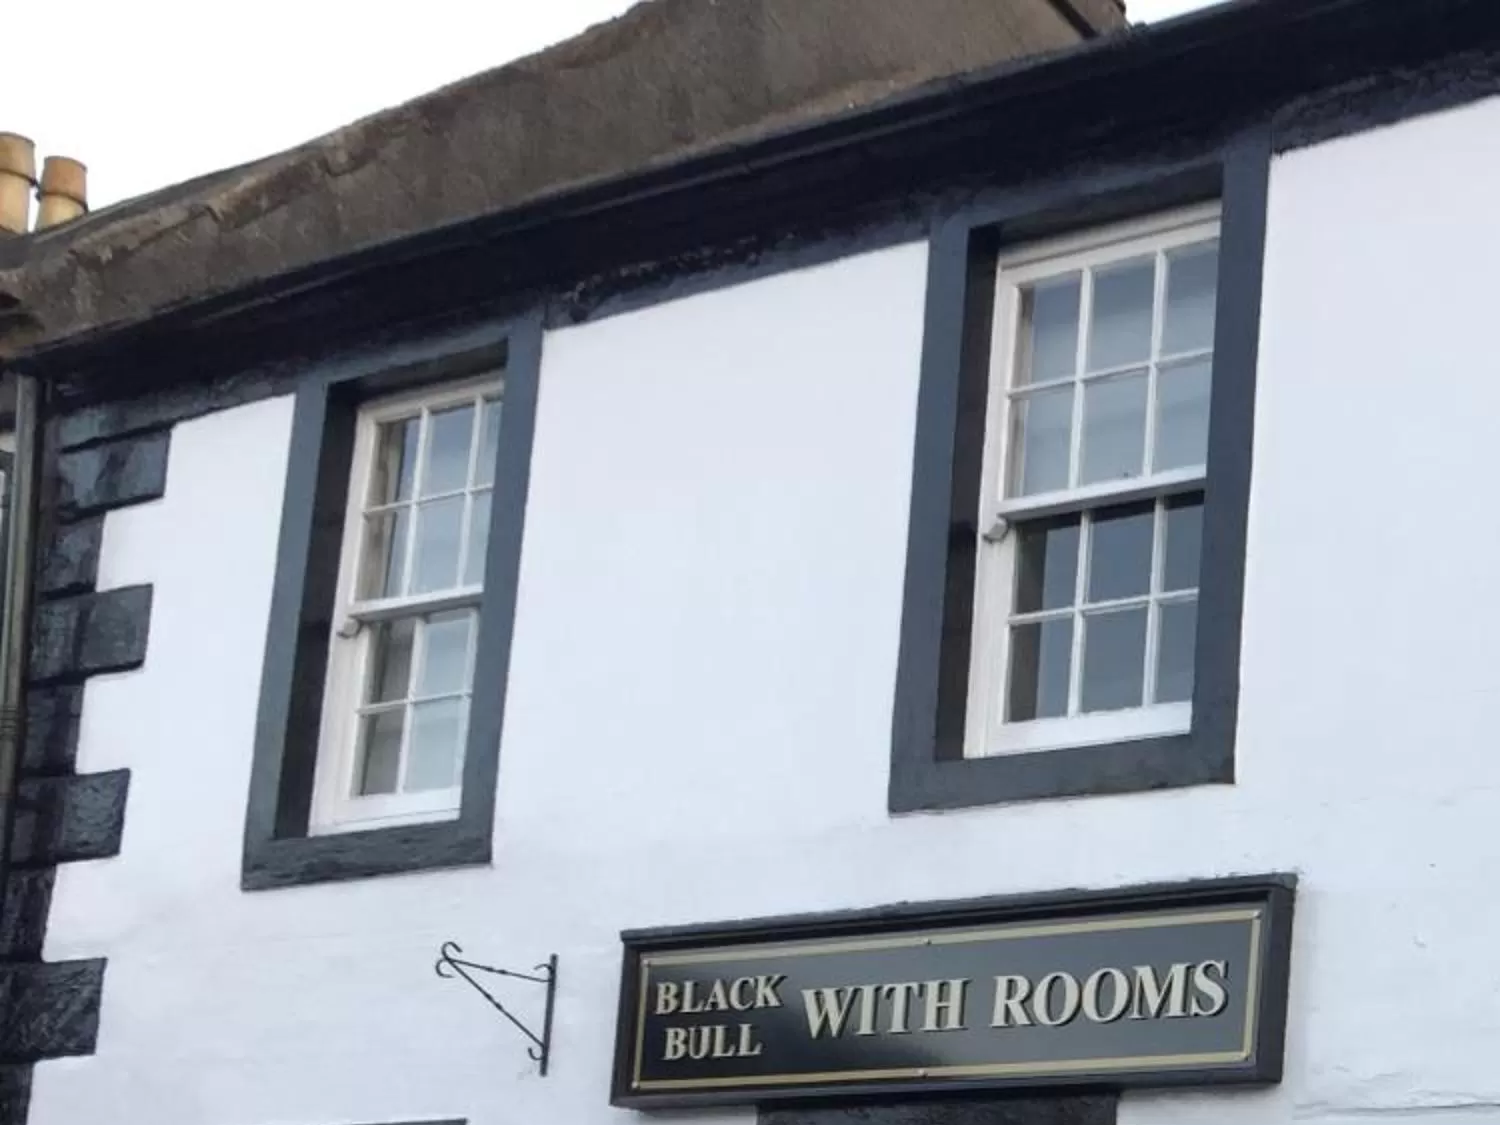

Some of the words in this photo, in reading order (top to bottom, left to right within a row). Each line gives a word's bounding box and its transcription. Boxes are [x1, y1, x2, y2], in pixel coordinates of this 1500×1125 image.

[655, 974, 786, 1015] BLACK
[801, 977, 971, 1039] WITH
[989, 960, 1229, 1029] ROOMS
[663, 1023, 763, 1061] BULL
